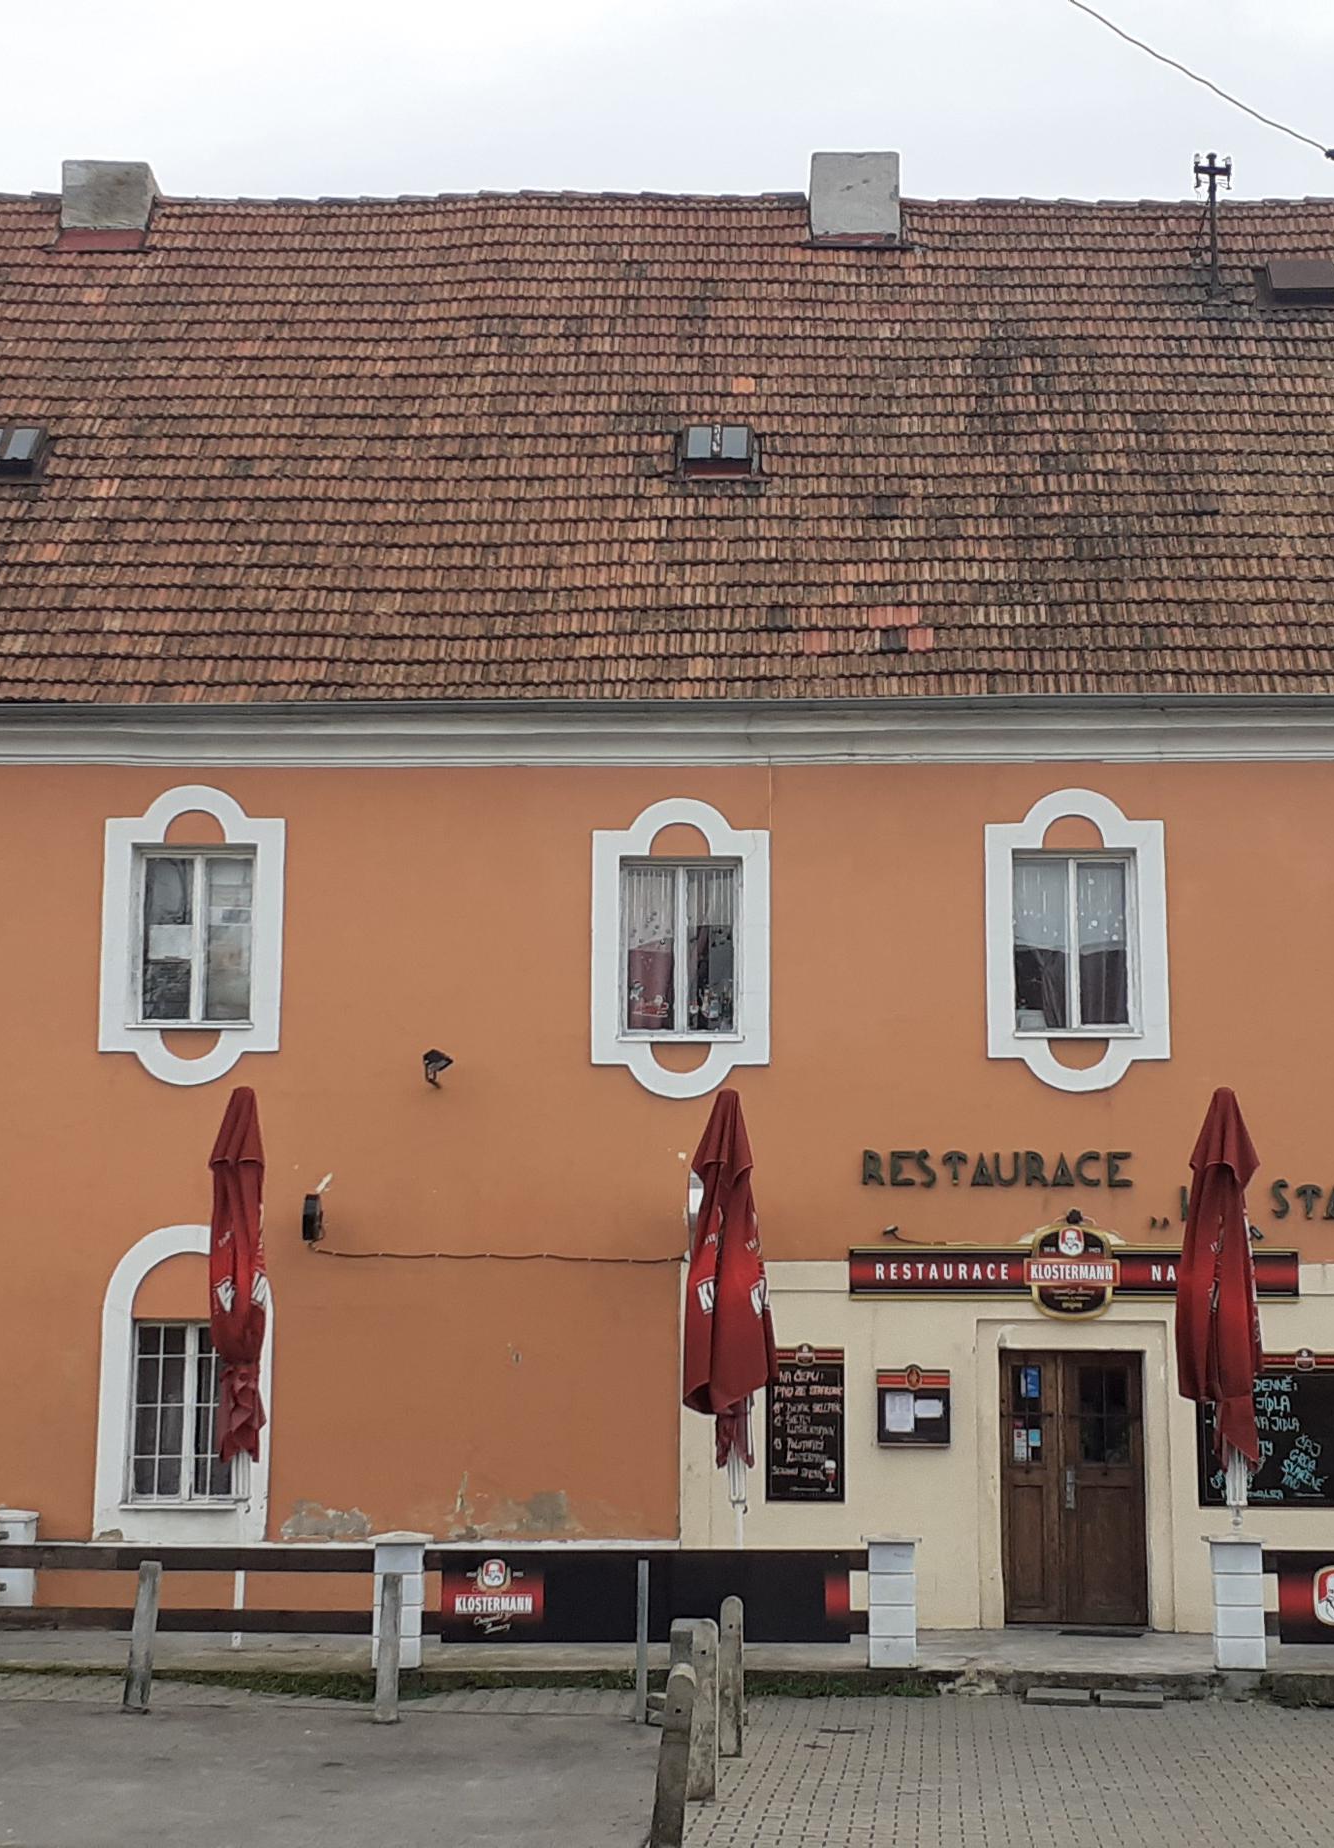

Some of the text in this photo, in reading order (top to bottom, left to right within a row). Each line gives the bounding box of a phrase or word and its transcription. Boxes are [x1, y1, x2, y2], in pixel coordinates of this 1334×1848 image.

[861, 1148, 1134, 1188] RESTAURACE
[875, 1262, 1177, 1282] RESTAURACE NA
[1030, 1264, 1114, 1281] KLOSTERMANN
[1255, 1391, 1291, 1413] JÍDLA
[455, 1596, 533, 1612] KLOSTERMANN
